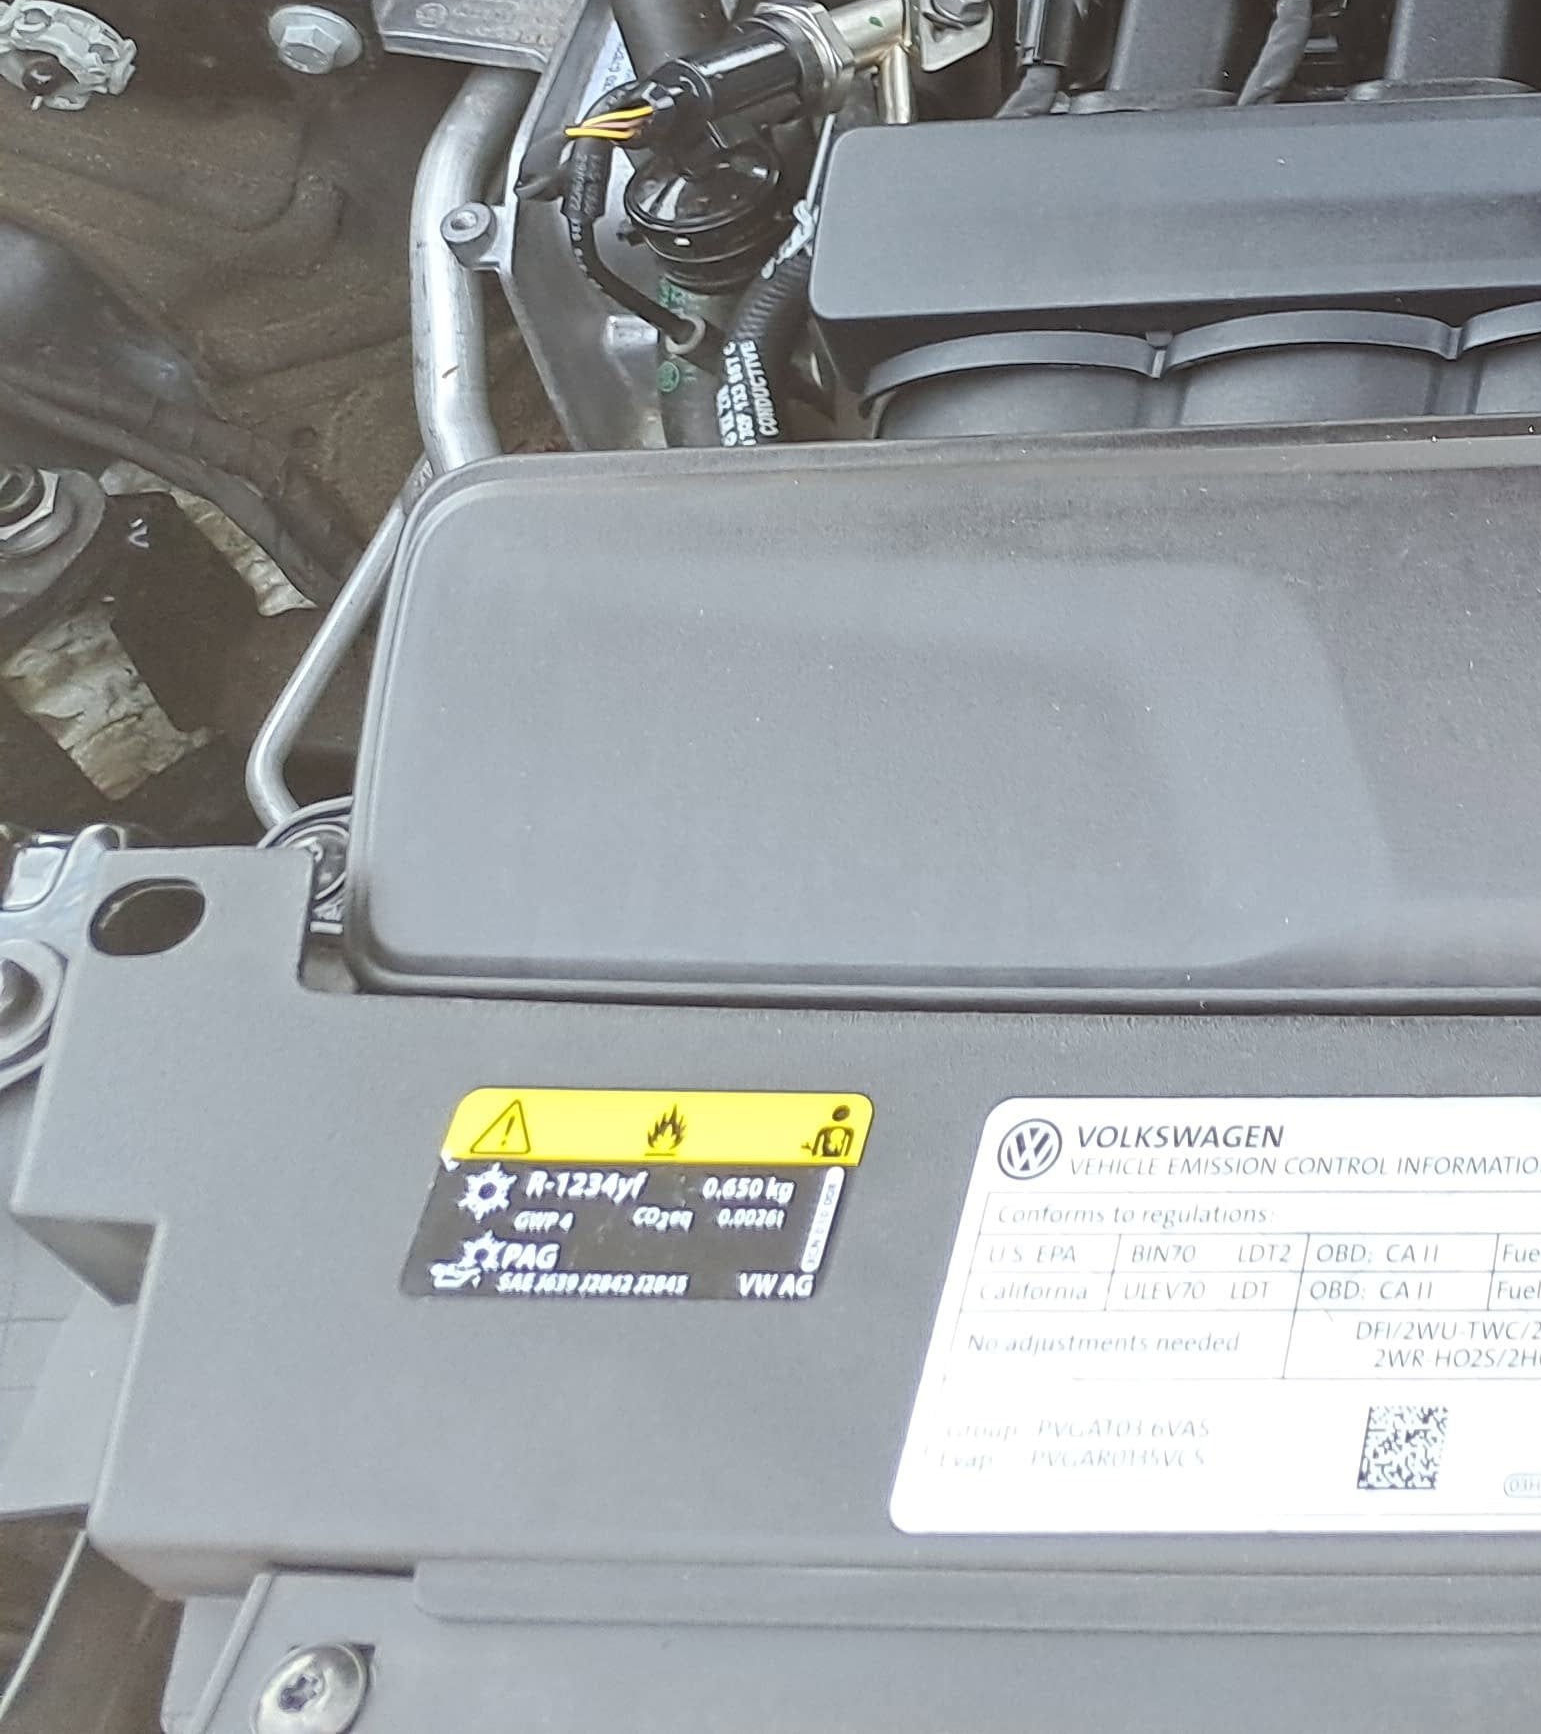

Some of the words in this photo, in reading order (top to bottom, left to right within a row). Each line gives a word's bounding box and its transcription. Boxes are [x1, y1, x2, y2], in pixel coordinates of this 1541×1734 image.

[738, 338, 780, 437] CONDUCTIVE
[1078, 1124, 1285, 1149] VOLKSWAGEN
[1070, 1156, 1159, 1177] VEHICLE
[1167, 1156, 1277, 1176] EMISSION
[1284, 1155, 1388, 1175] CONTROL
[525, 1169, 649, 1204] R-1234yf
[702, 1175, 765, 1201] 0.650
[766, 1175, 797, 1205] kg
[513, 1210, 557, 1233] GWP
[998, 1203, 1106, 1225] Conforms
[1113, 1205, 1135, 1224] to
[502, 1243, 561, 1270] PAG
[1035, 1245, 1077, 1263] EPA
[1131, 1244, 1197, 1263] BIN70
[1238, 1243, 1291, 1263] LDT2
[1385, 1244, 1416, 1263] CA
[495, 1273, 536, 1295] SAE
[738, 1272, 779, 1299] VW
[777, 1272, 817, 1299] AG
[1123, 1280, 1206, 1301] ULEV70
[1229, 1280, 1272, 1300] LDT
[1378, 1280, 1410, 1300] CA
[967, 1333, 999, 1352] No
[1004, 1331, 1149, 1357] adjustments
[1155, 1330, 1241, 1353] needed
